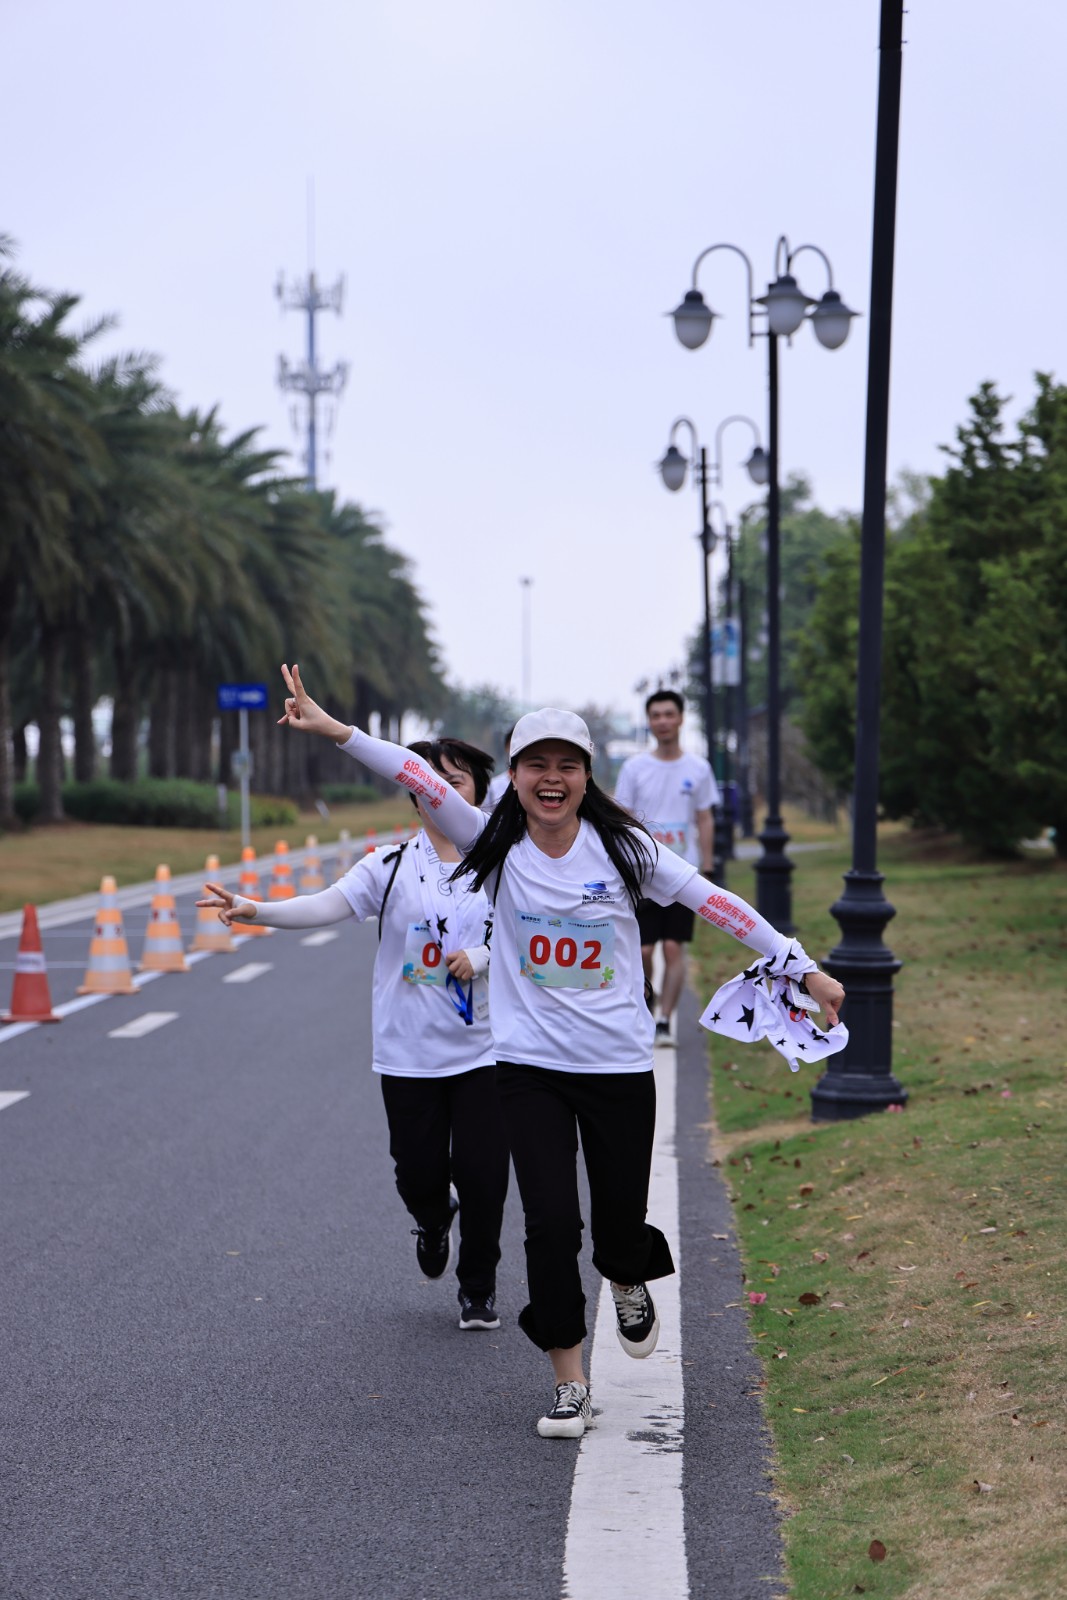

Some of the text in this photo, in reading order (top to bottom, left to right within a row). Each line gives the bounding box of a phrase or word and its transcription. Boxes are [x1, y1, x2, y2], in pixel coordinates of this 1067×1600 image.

[395, 771, 442, 810] 和你在一起
[403, 759, 447, 799] 618京东手机
[697, 905, 748, 939] 和你在一起
[707, 894, 756, 931] 618京东手机
[529, 935, 602, 970] 002
